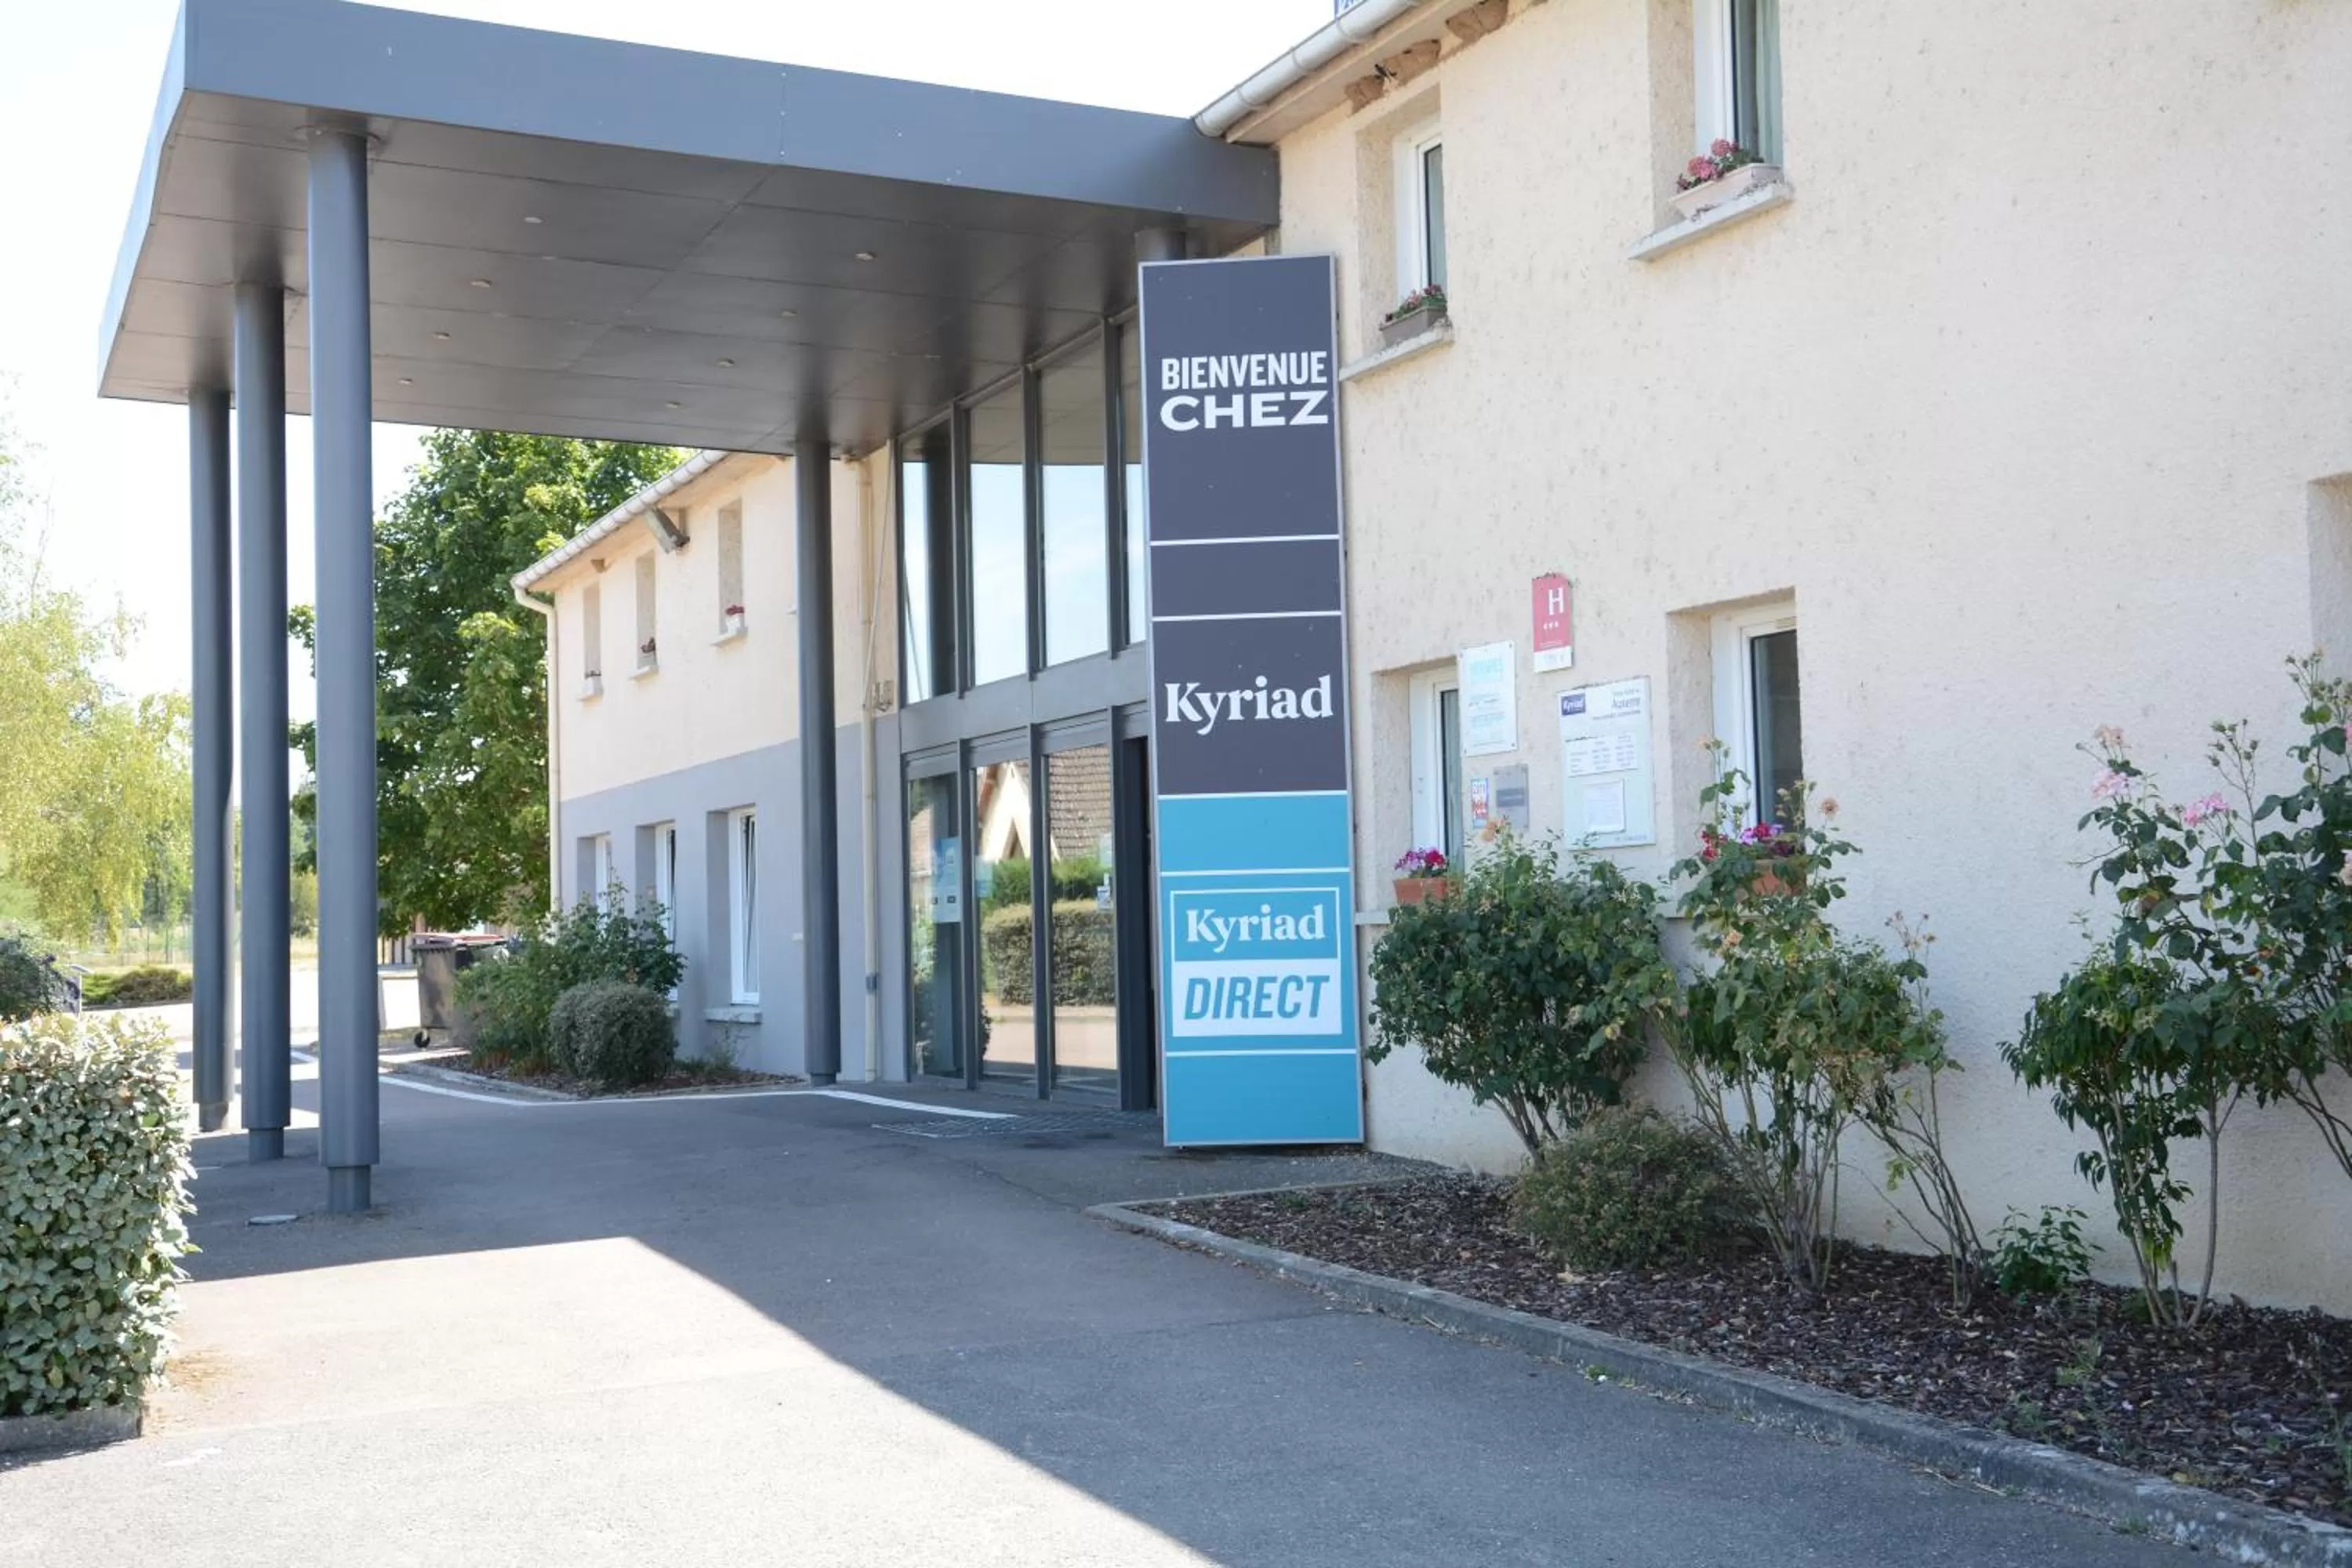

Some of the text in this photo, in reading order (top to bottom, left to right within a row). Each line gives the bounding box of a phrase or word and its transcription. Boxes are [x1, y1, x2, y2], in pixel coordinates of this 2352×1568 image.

[1160, 350, 1328, 390] BIENVENUE
[1160, 390, 1329, 431] CHEZ
[1548, 586, 1564, 615] H
[1165, 674, 1334, 735] Kyriad
[1185, 903, 1325, 953] Kyriad
[1184, 975, 1330, 1020] DIRECT
